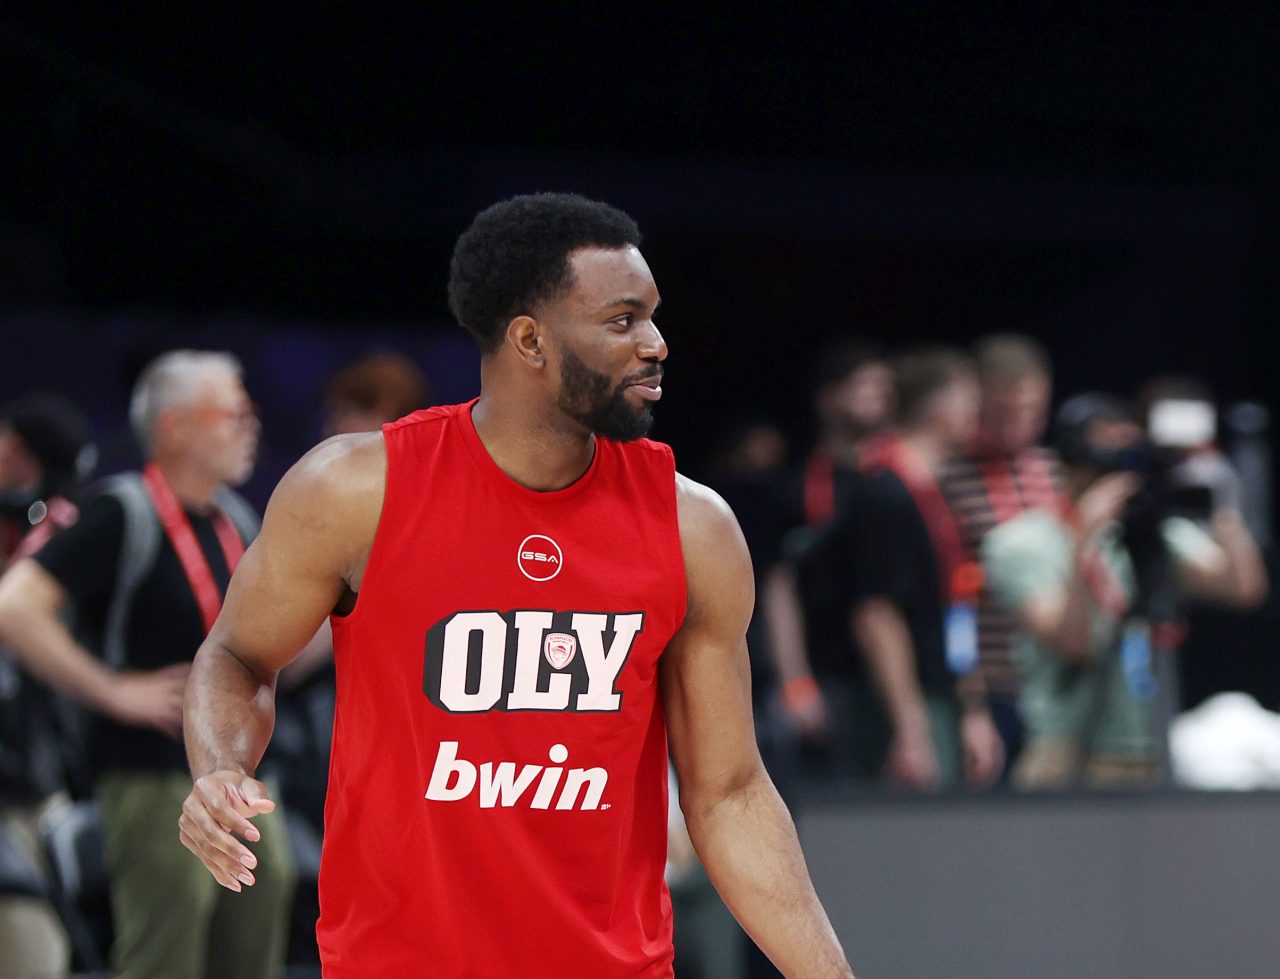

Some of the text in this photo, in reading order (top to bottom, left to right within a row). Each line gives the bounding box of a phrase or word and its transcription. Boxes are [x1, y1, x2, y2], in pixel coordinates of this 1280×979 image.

[520, 551, 559, 564] GSA
[439, 610, 644, 712] OLY
[424, 741, 609, 811] bwin
